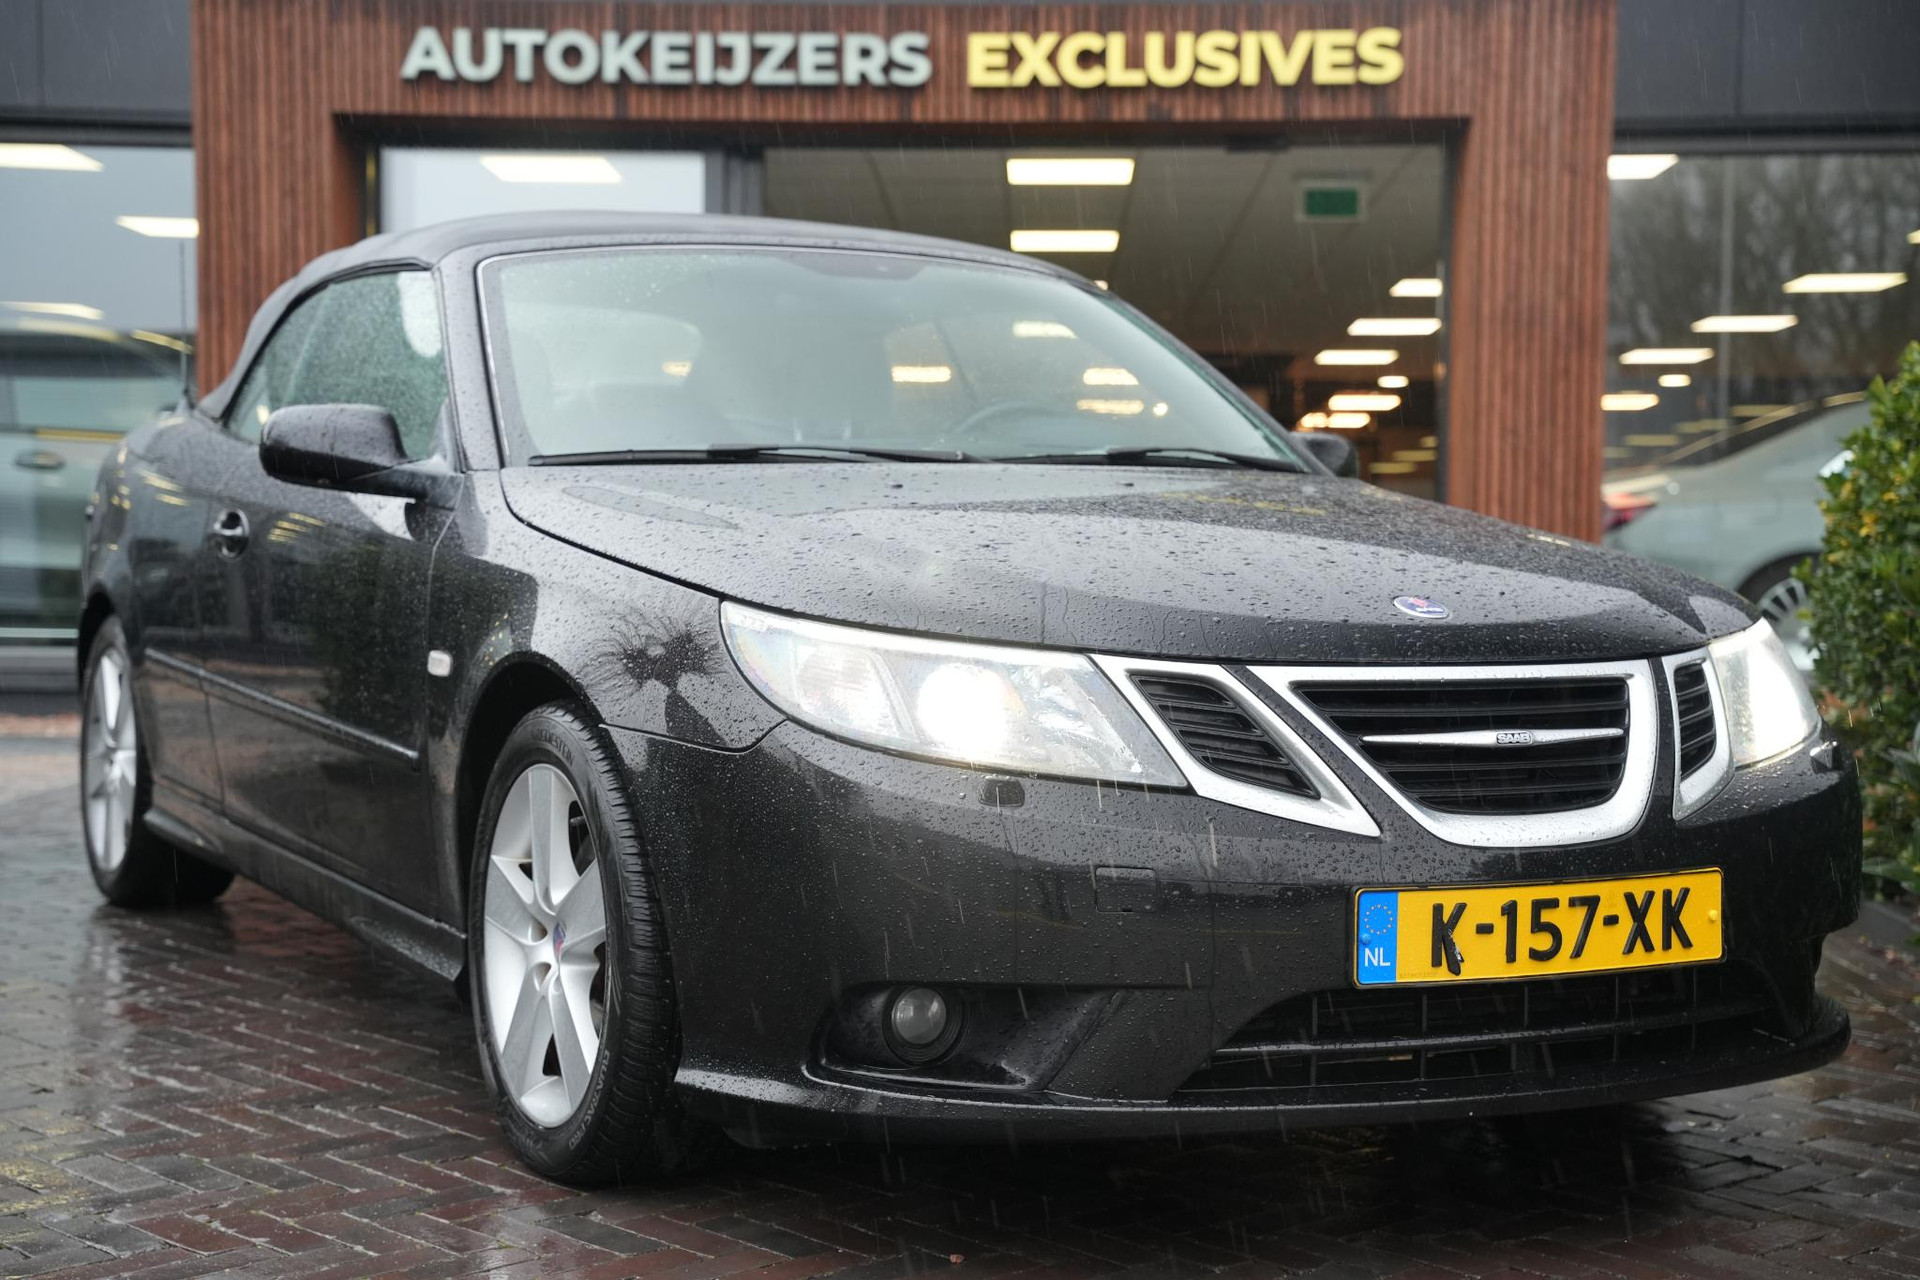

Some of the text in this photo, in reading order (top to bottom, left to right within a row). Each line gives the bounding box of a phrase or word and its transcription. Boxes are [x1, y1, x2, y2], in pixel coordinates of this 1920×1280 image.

[402, 26, 1404, 88] AUTOKEIJZERS EXCLUSIVES
[1497, 733, 1530, 743] SAAB
[1431, 888, 1693, 975] K-157-XK
[1364, 948, 1391, 967] NL
